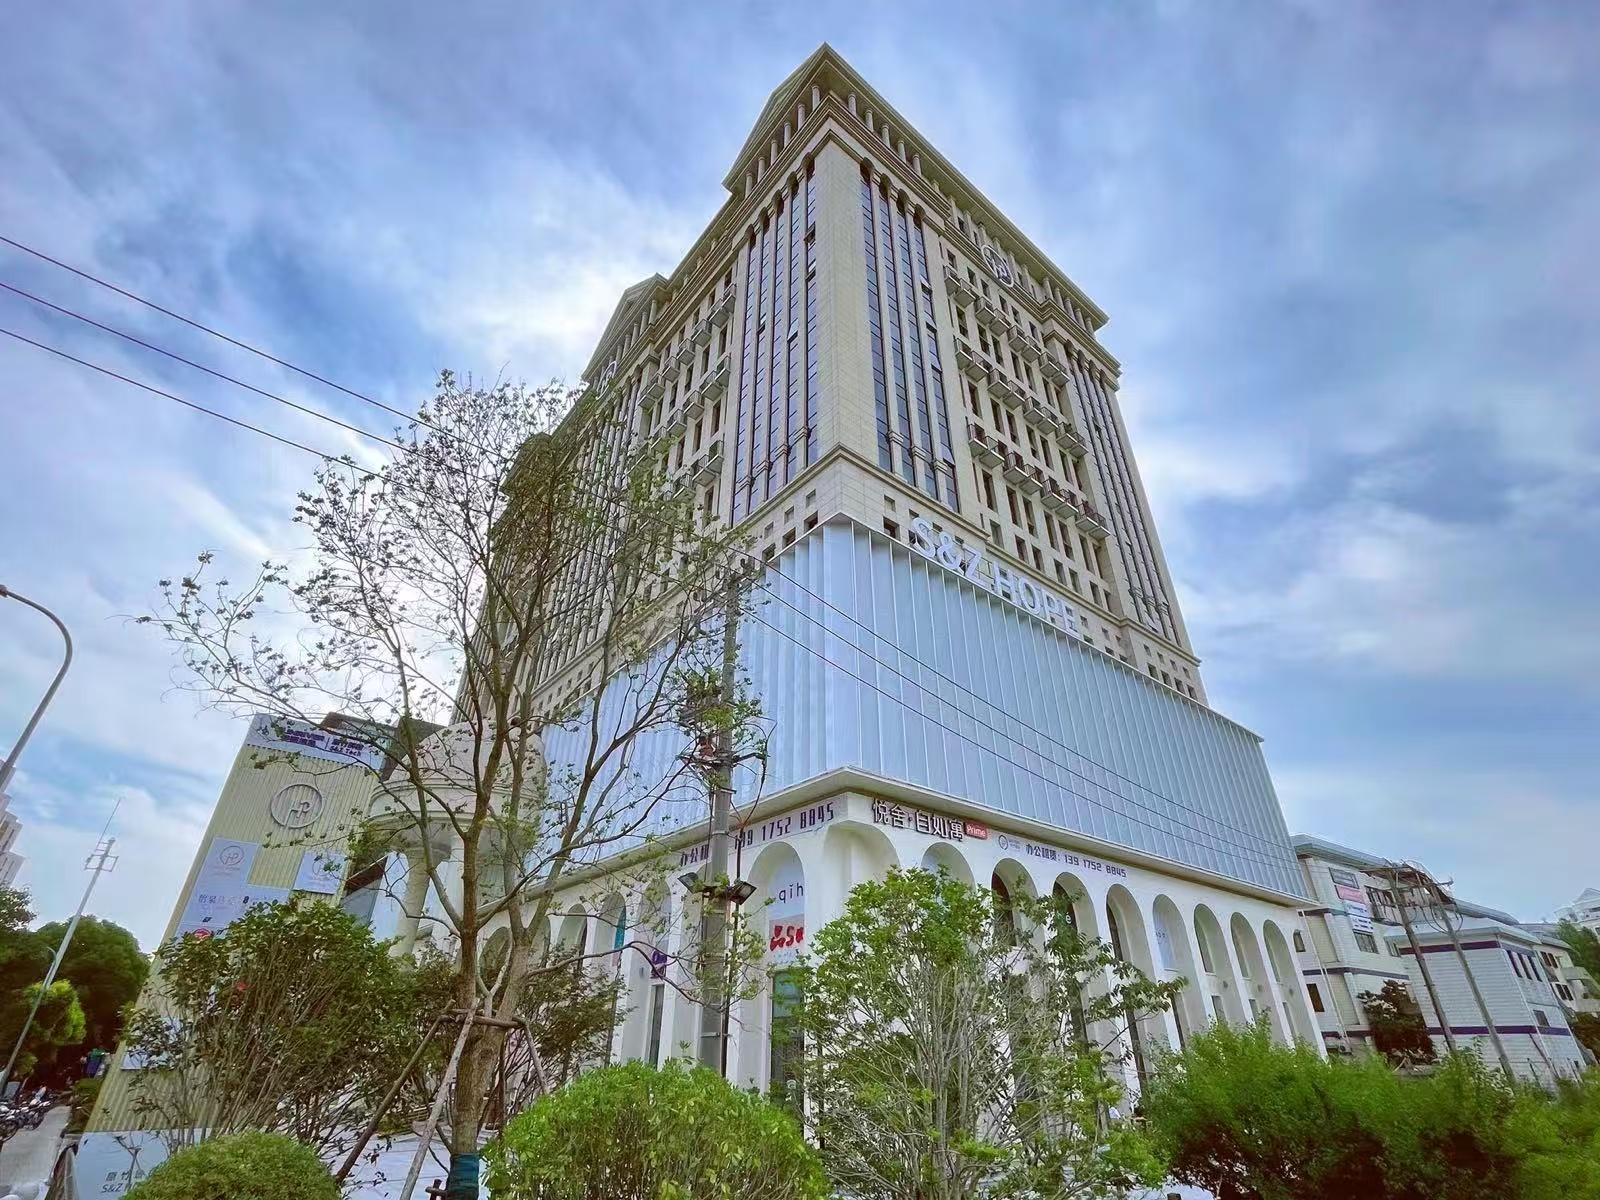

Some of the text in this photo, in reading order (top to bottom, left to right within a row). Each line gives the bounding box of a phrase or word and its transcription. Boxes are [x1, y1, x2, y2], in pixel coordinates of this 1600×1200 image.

[912, 517, 1084, 639] S&Z HOPE
[762, 816, 791, 841] 1752
[800, 801, 834, 829] 8845
[966, 823, 987, 838] Prime
[1064, 854, 1079, 866] 139
[1083, 859, 1102, 872] 1752
[1105, 865, 1127, 878] 8845
